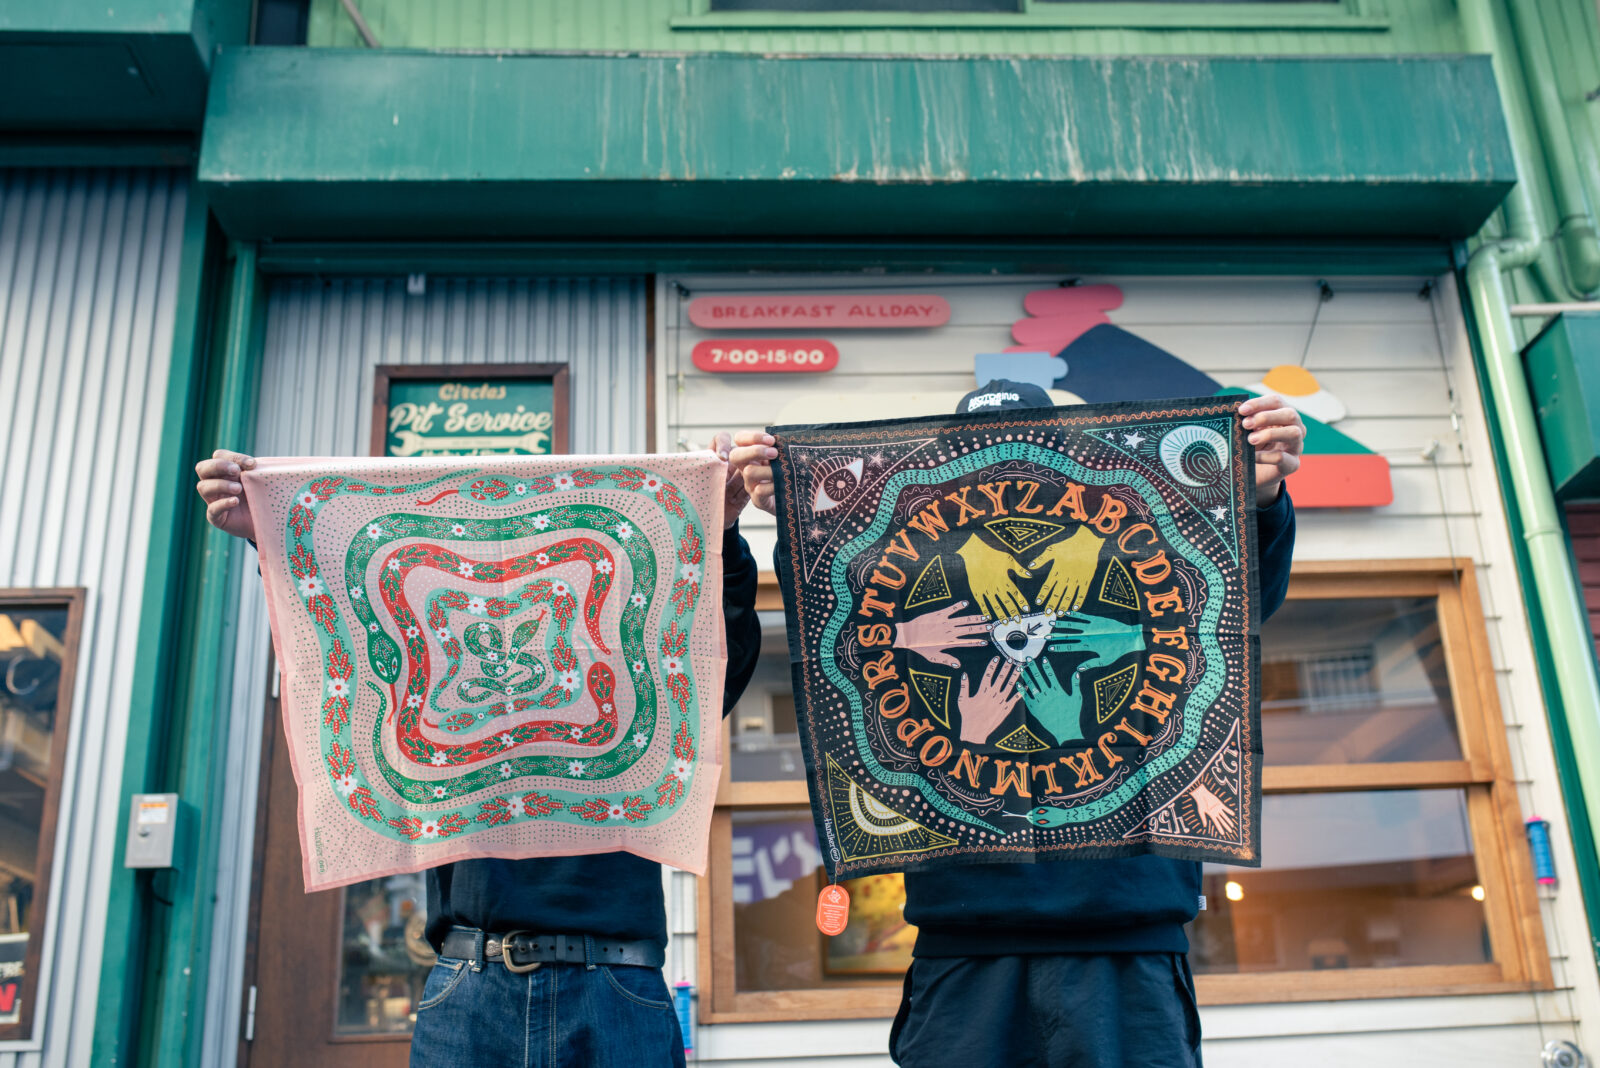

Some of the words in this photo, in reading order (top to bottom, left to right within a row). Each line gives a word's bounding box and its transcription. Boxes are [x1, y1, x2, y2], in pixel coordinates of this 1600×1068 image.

[711, 304, 836, 319] BREAKFAST
[847, 303, 934, 318] ALLDAY
[710, 348, 825, 364] 7:00-15:00
[389, 402, 444, 433] Pit
[443, 402, 553, 433] Service
